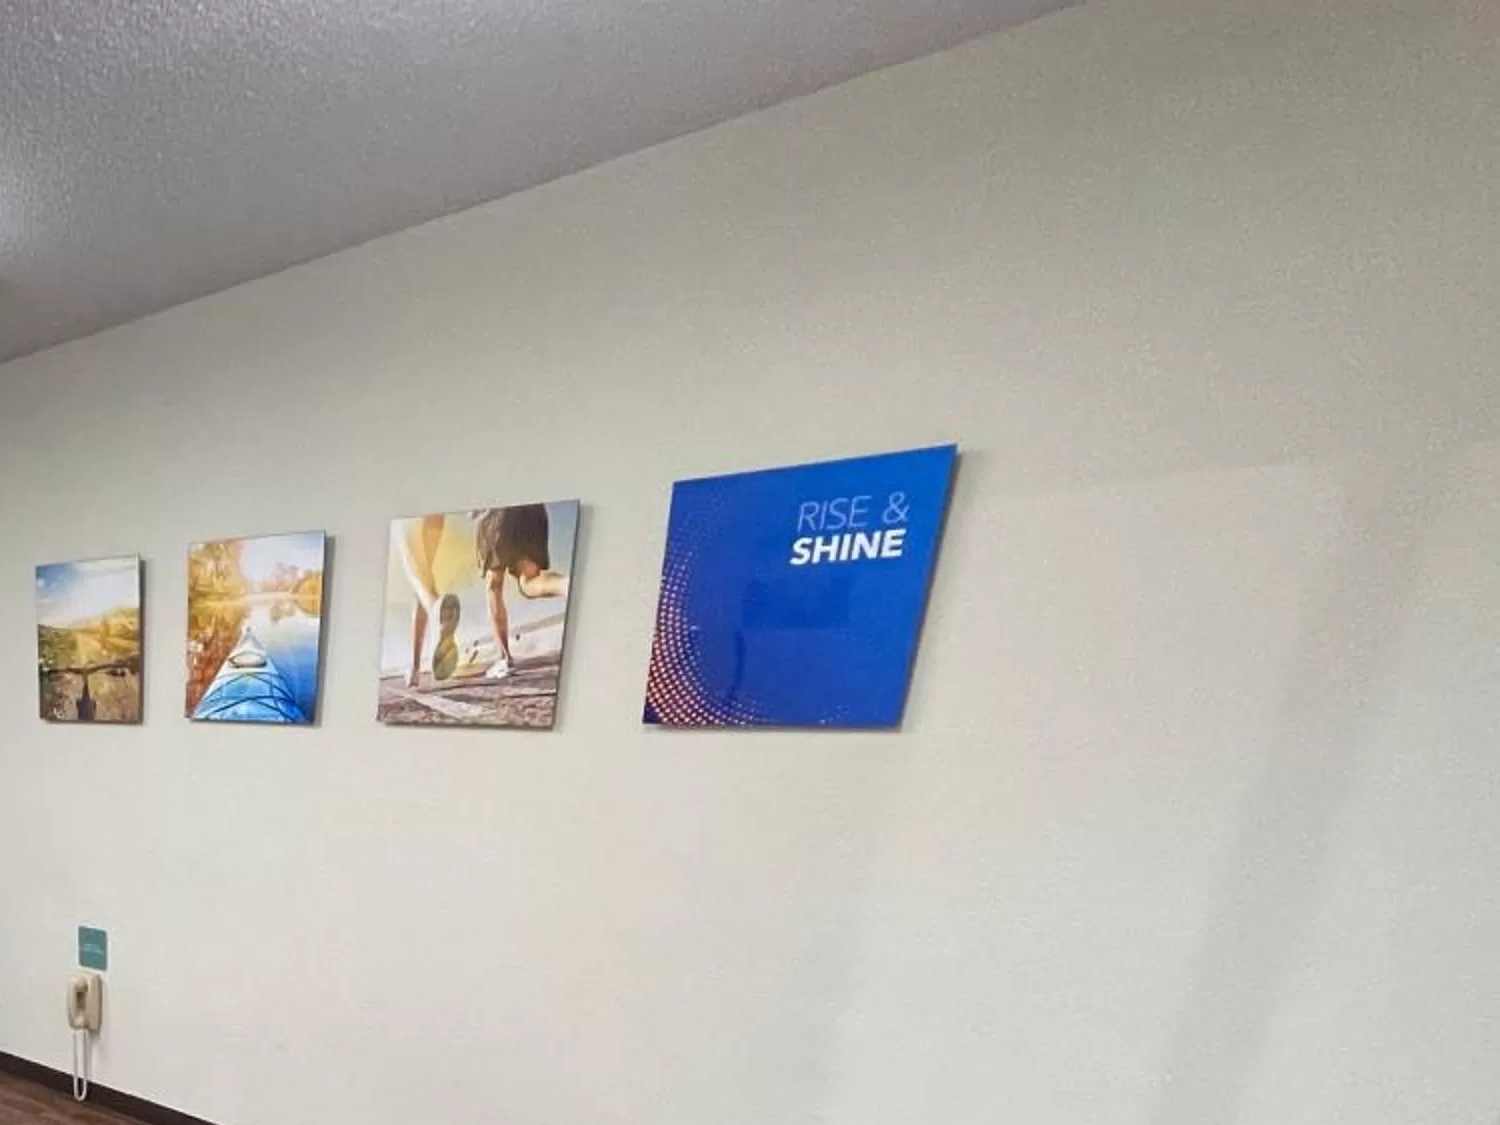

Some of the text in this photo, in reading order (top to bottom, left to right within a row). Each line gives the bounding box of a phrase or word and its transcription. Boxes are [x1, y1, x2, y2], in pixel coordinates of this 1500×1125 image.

[797, 491, 911, 533] RISE &
[790, 527, 907, 566] SHINE
